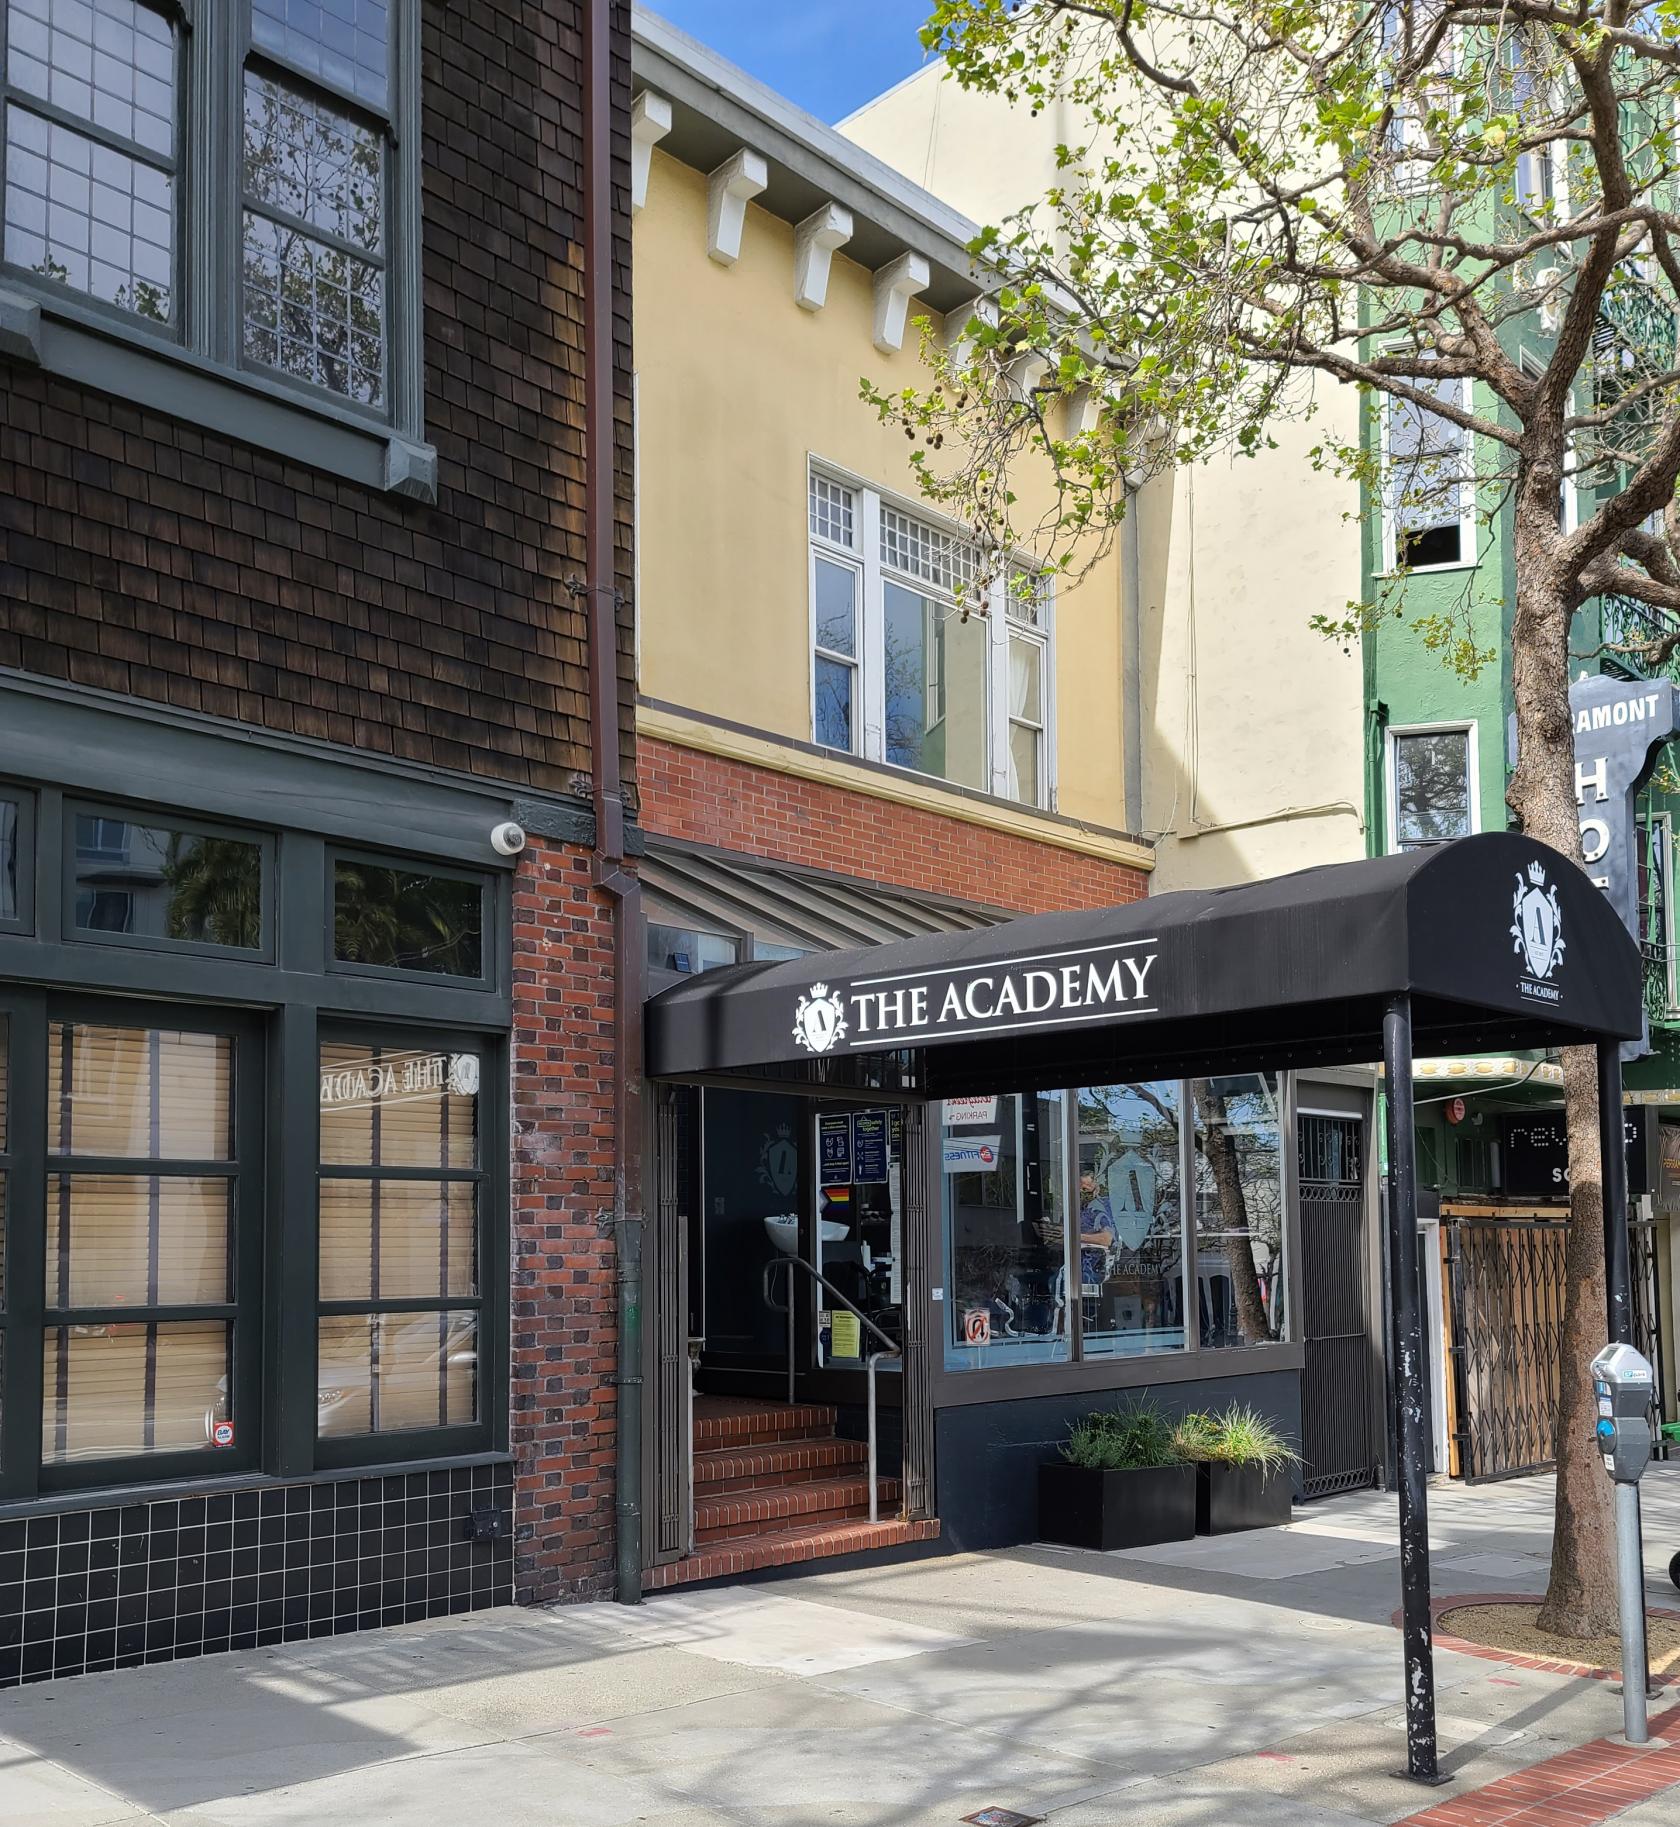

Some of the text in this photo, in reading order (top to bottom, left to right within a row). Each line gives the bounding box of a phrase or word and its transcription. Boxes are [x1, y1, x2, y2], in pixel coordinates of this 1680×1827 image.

[1572, 694, 1660, 734] AMONT
[850, 954, 1158, 1033] THE ACADEMY
[1519, 982, 1560, 1001] THE ACADEMY
